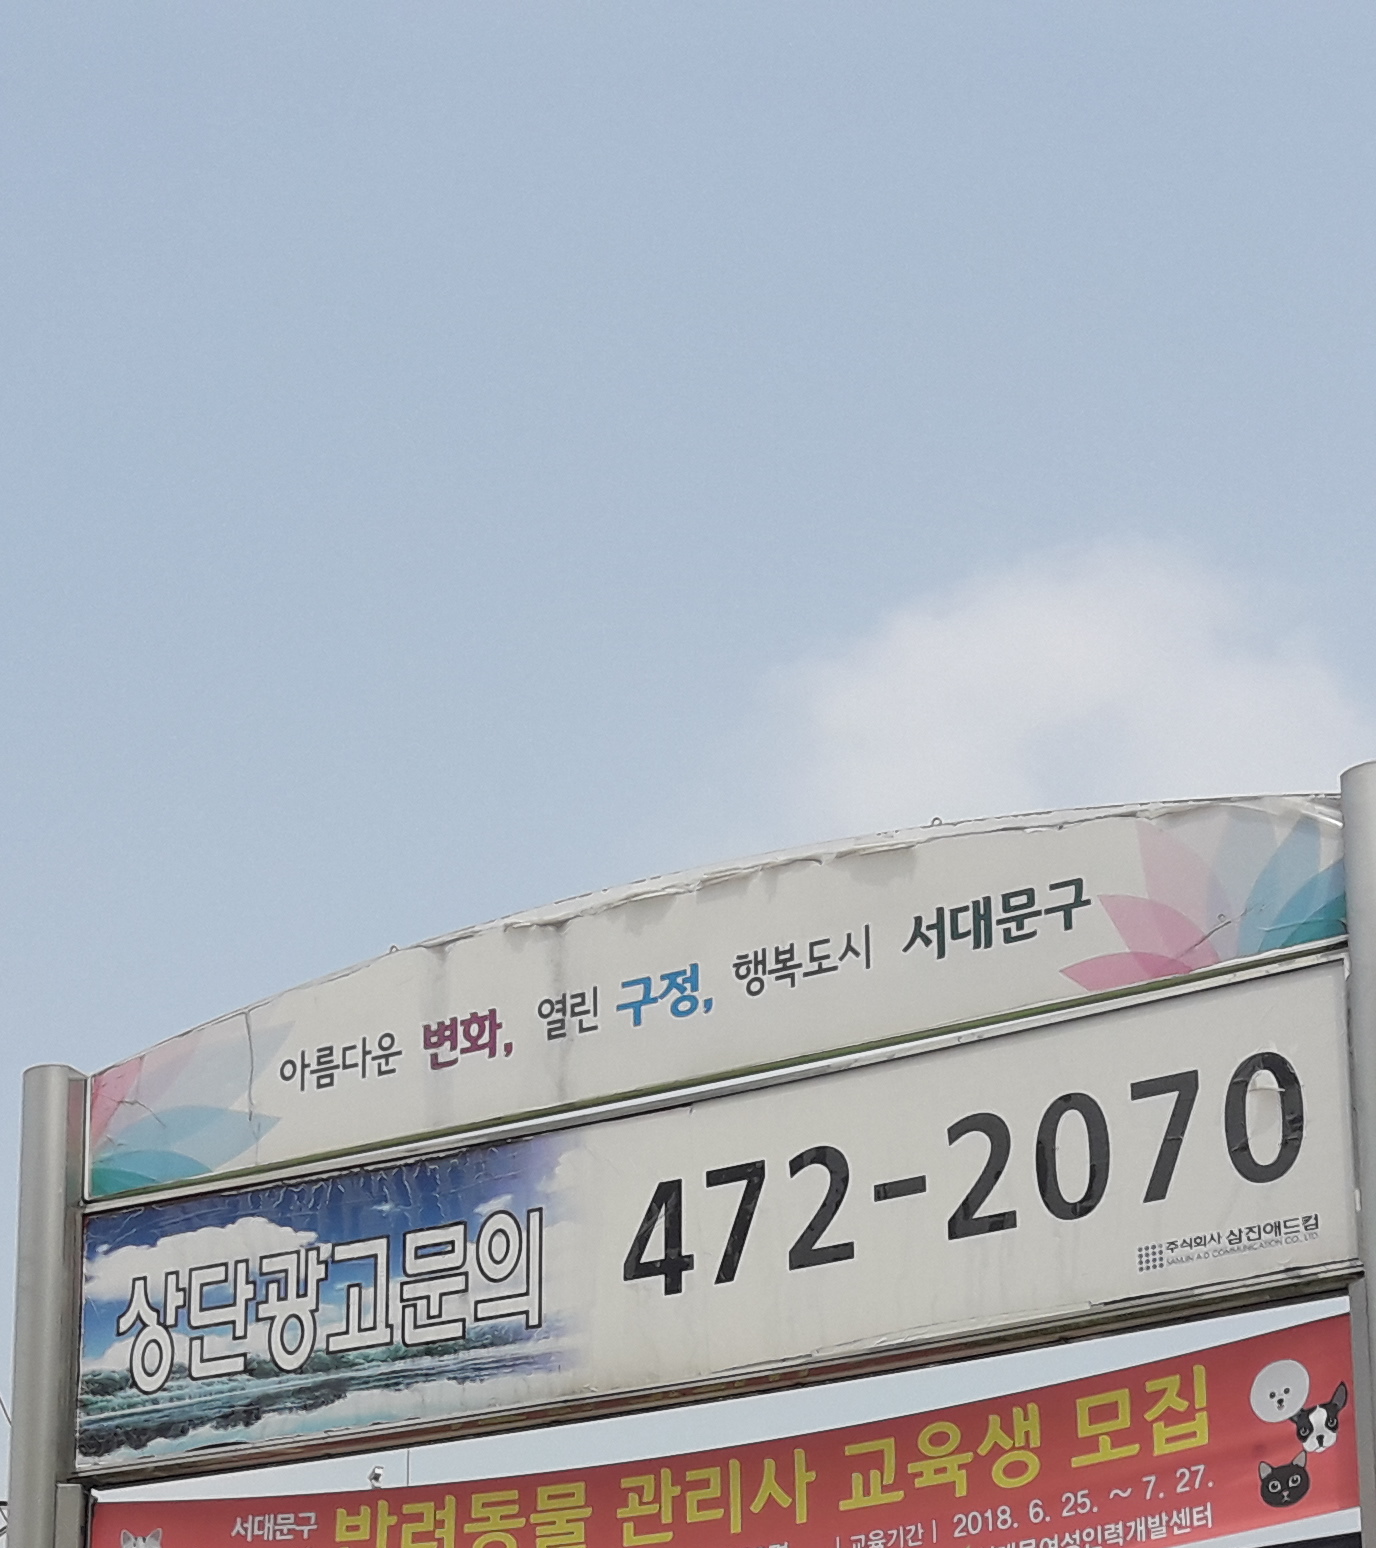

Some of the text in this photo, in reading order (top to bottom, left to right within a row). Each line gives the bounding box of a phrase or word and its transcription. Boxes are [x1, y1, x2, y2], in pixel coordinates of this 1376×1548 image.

[279, 877, 1091, 1092] 아름다운 변화, 열린 구정, 행복도시 서대문구
[624, 1052, 1304, 1296] 472-2070
[1166, 1231, 1222, 1253] 주식회사
[116, 1206, 542, 1395] 상단광고문의
[231, 1512, 318, 1542] 서대문구
[616, 1448, 816, 1548] 관리사
[838, 1402, 1042, 1511] 교육생
[1070, 1364, 1209, 1470] 모집
[953, 1507, 1019, 1539] 2018.
[1029, 1498, 1051, 1524] 6.
[1061, 1489, 1099, 1518] 25.
[1142, 1475, 1165, 1501] 7.
[1176, 1465, 1214, 1493] 27.
